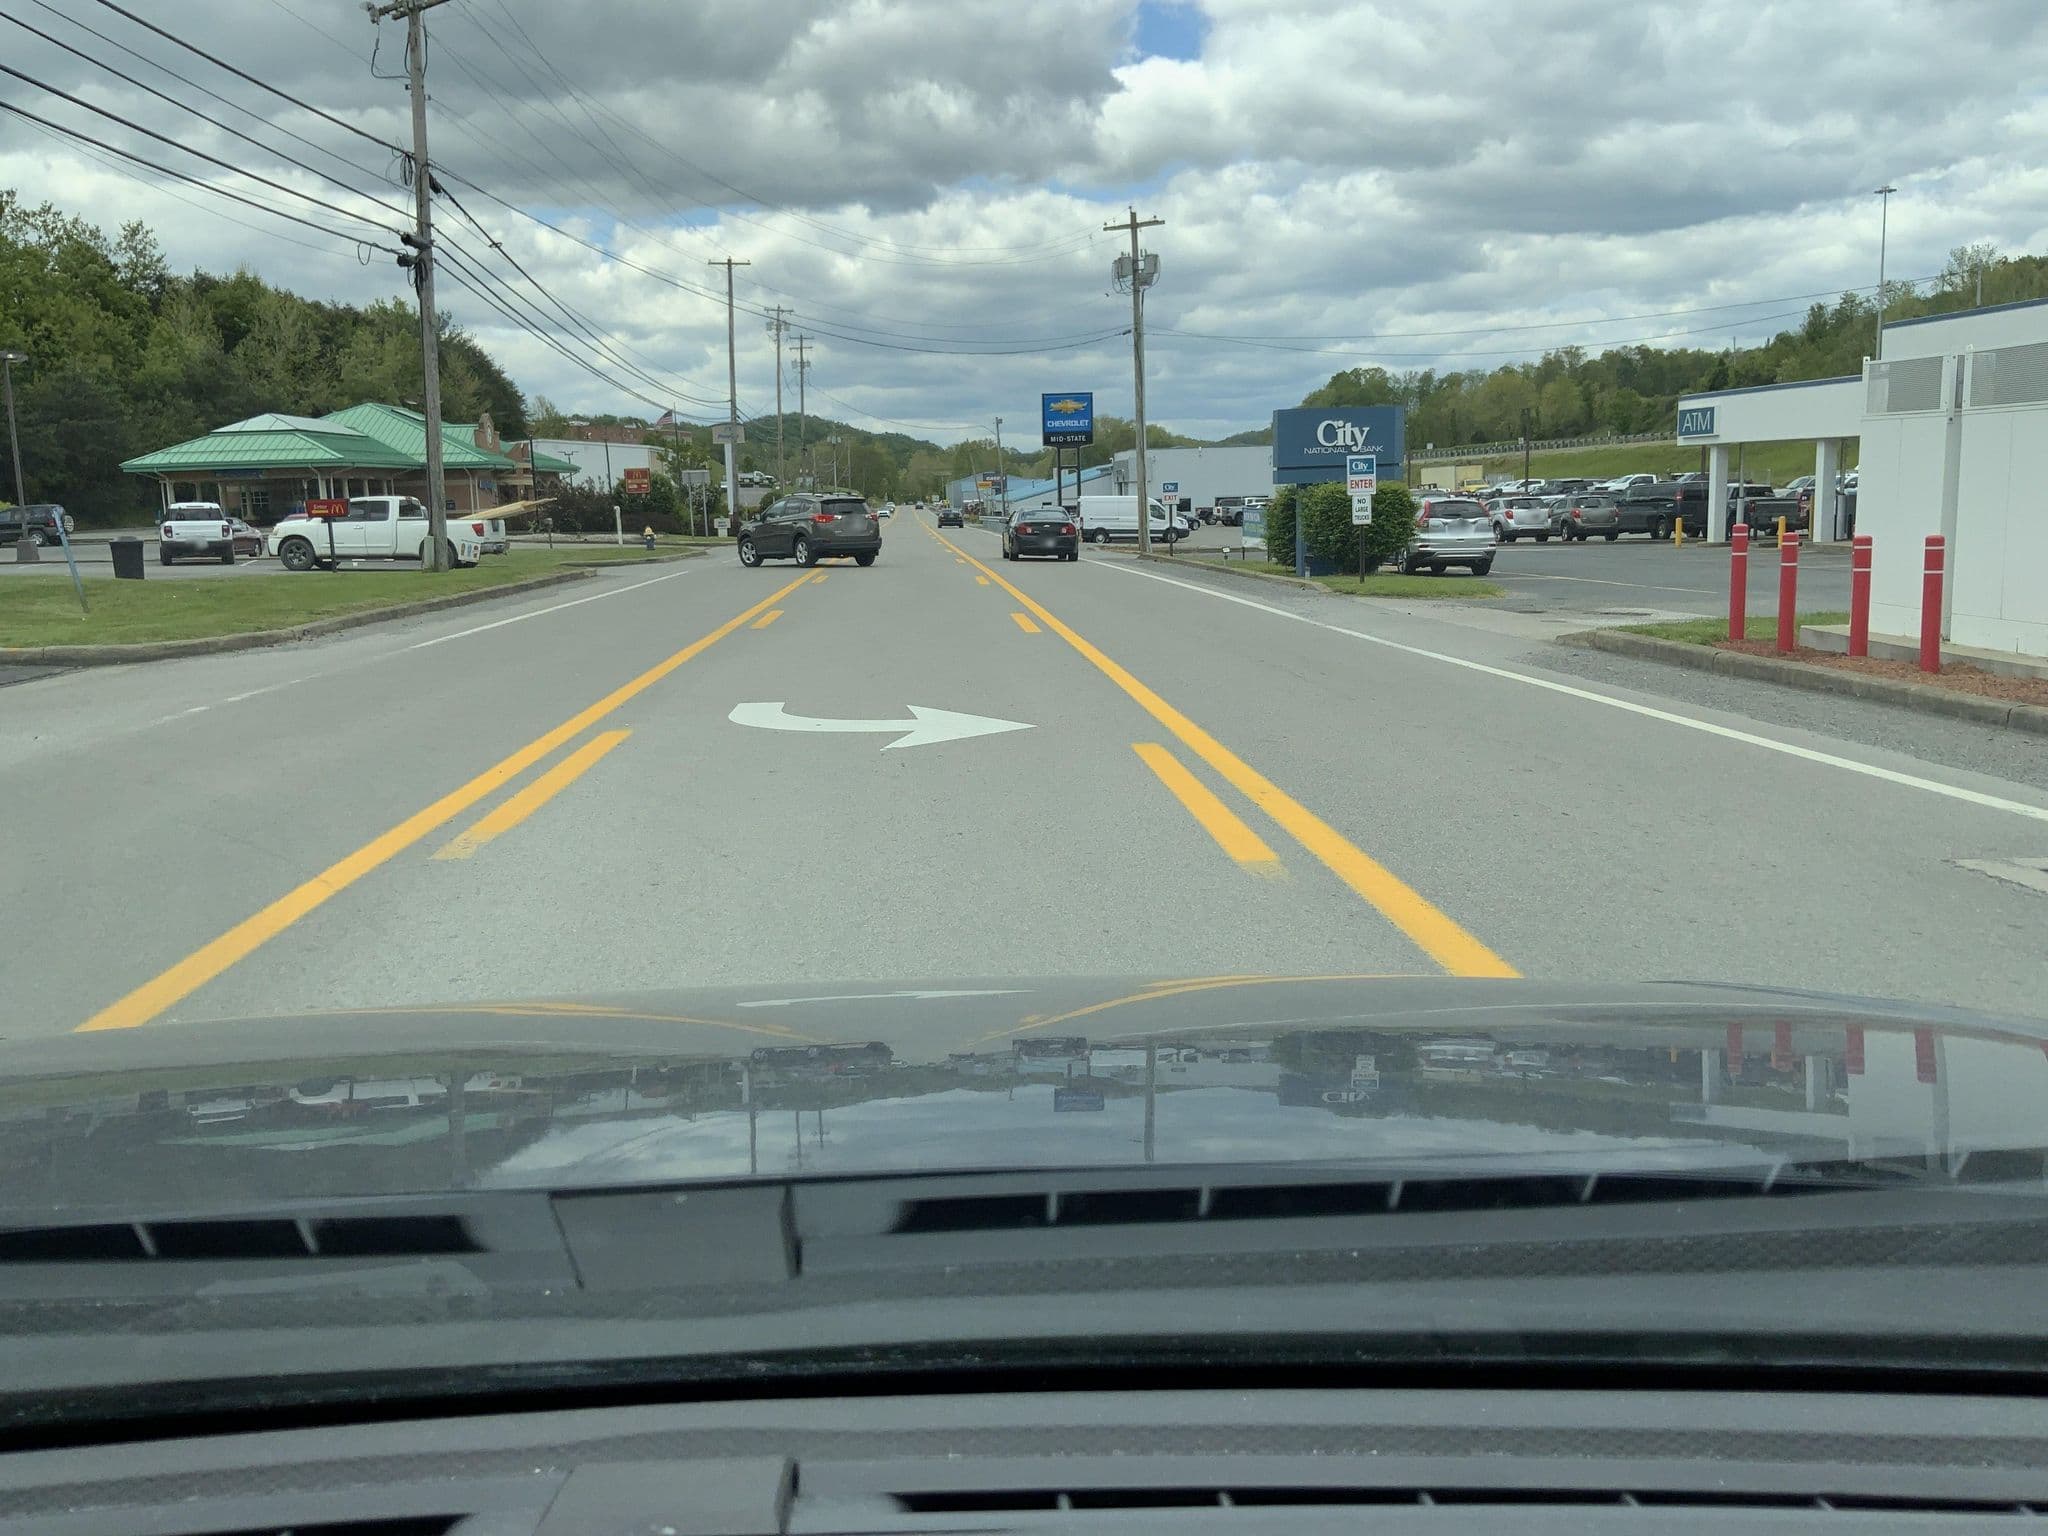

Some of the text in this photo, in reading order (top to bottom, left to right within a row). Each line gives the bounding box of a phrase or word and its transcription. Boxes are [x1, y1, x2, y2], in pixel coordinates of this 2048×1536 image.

[1682, 411, 1711, 432] ATM
[1317, 420, 1370, 452] City
[1304, 445, 1385, 454] NATIONAL BANK
[1352, 461, 1369, 471] City
[1351, 479, 1373, 489] ENTER
